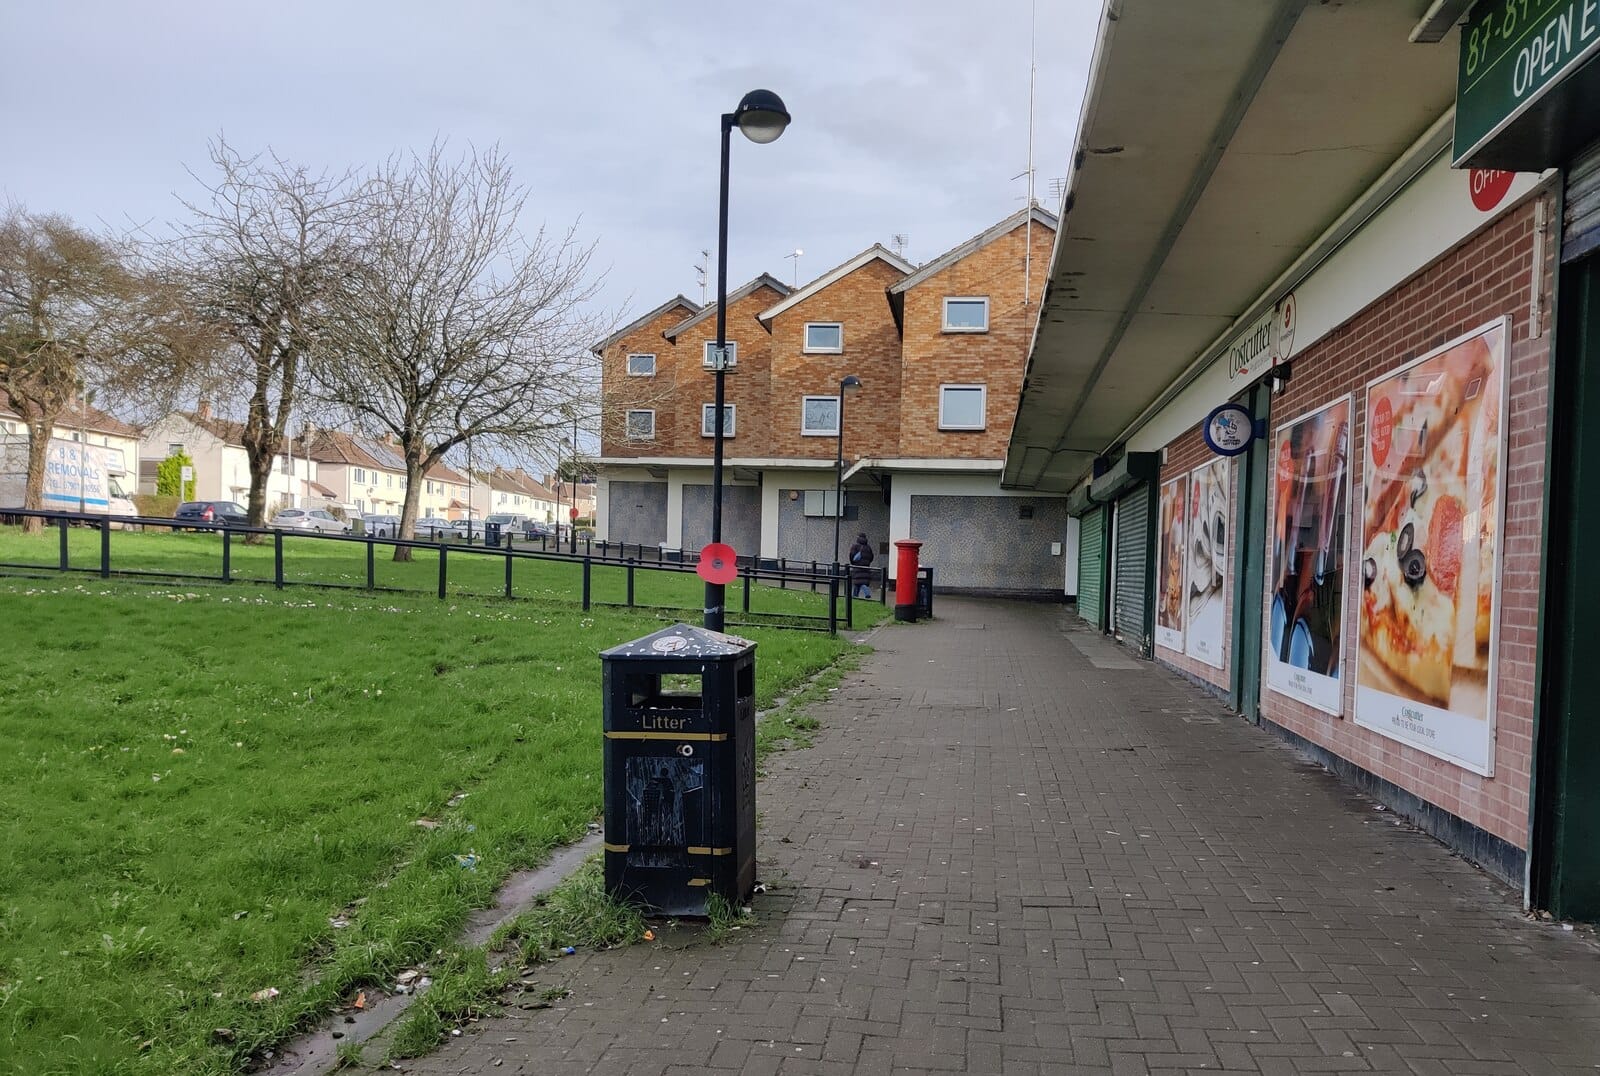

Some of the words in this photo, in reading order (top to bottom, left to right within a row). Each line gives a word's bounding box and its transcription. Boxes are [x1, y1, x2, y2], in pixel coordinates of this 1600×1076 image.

[1513, 3, 1574, 98] OPEN
[1474, 168, 1507, 194] OFF
[1228, 321, 1272, 380] Costcutter
[47, 462, 100, 480] REMOVALS
[642, 714, 687, 730] Litter
